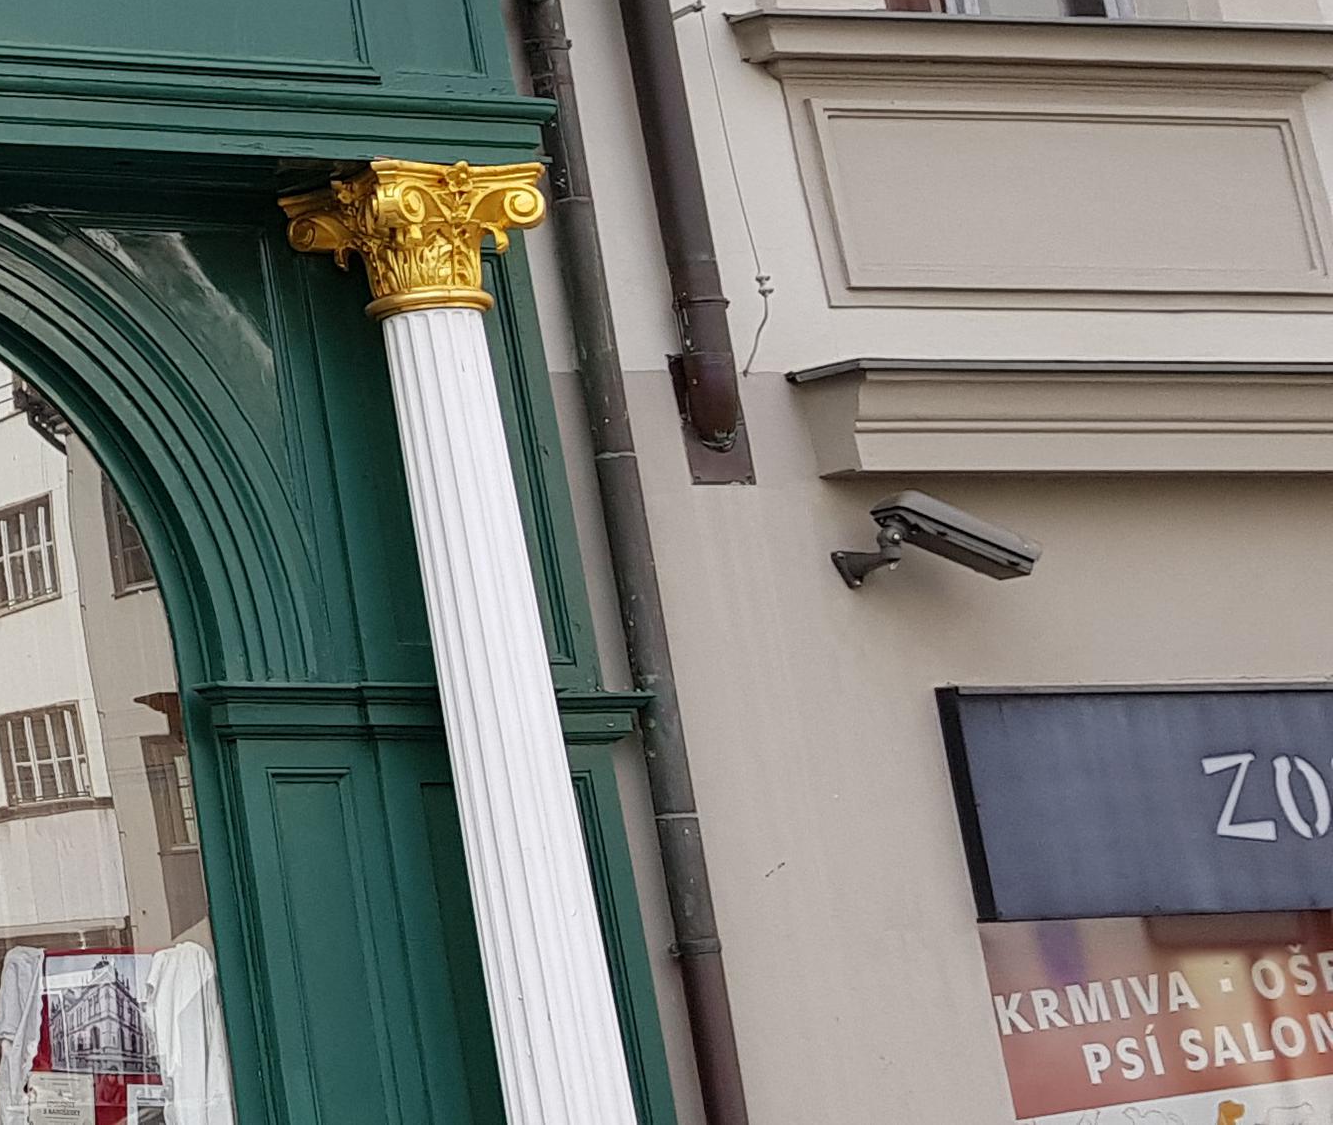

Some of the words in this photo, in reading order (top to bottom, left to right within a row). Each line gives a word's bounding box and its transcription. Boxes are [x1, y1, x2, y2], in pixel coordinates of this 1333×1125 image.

[1201, 752, 1333, 842] ZO
[993, 970, 1201, 1036] KRMIVA
[1081, 1023, 1166, 1085] PSÍ
[1179, 1010, 1333, 1072] SALON
